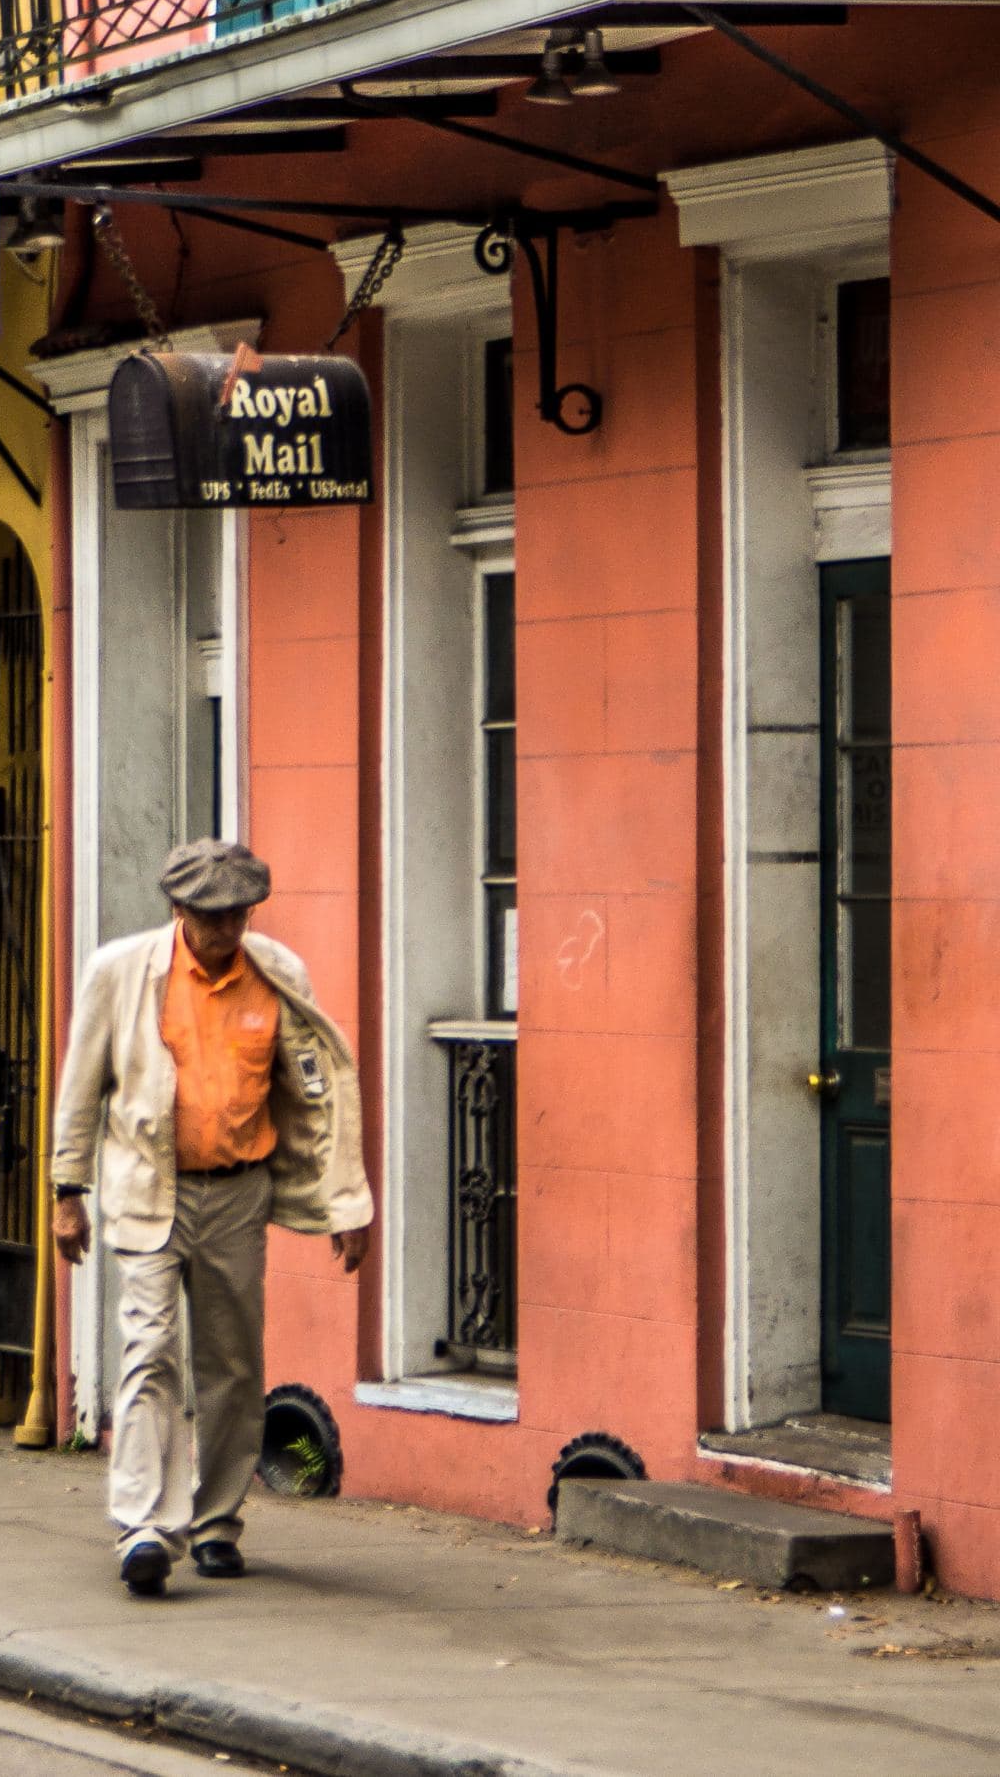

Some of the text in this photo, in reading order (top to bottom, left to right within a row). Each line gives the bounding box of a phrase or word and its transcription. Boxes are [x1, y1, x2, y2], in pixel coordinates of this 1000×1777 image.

[230, 375, 333, 427] Royal
[243, 432, 325, 475] Mail
[200, 480, 231, 500] UPS
[249, 480, 291, 500] FedEx
